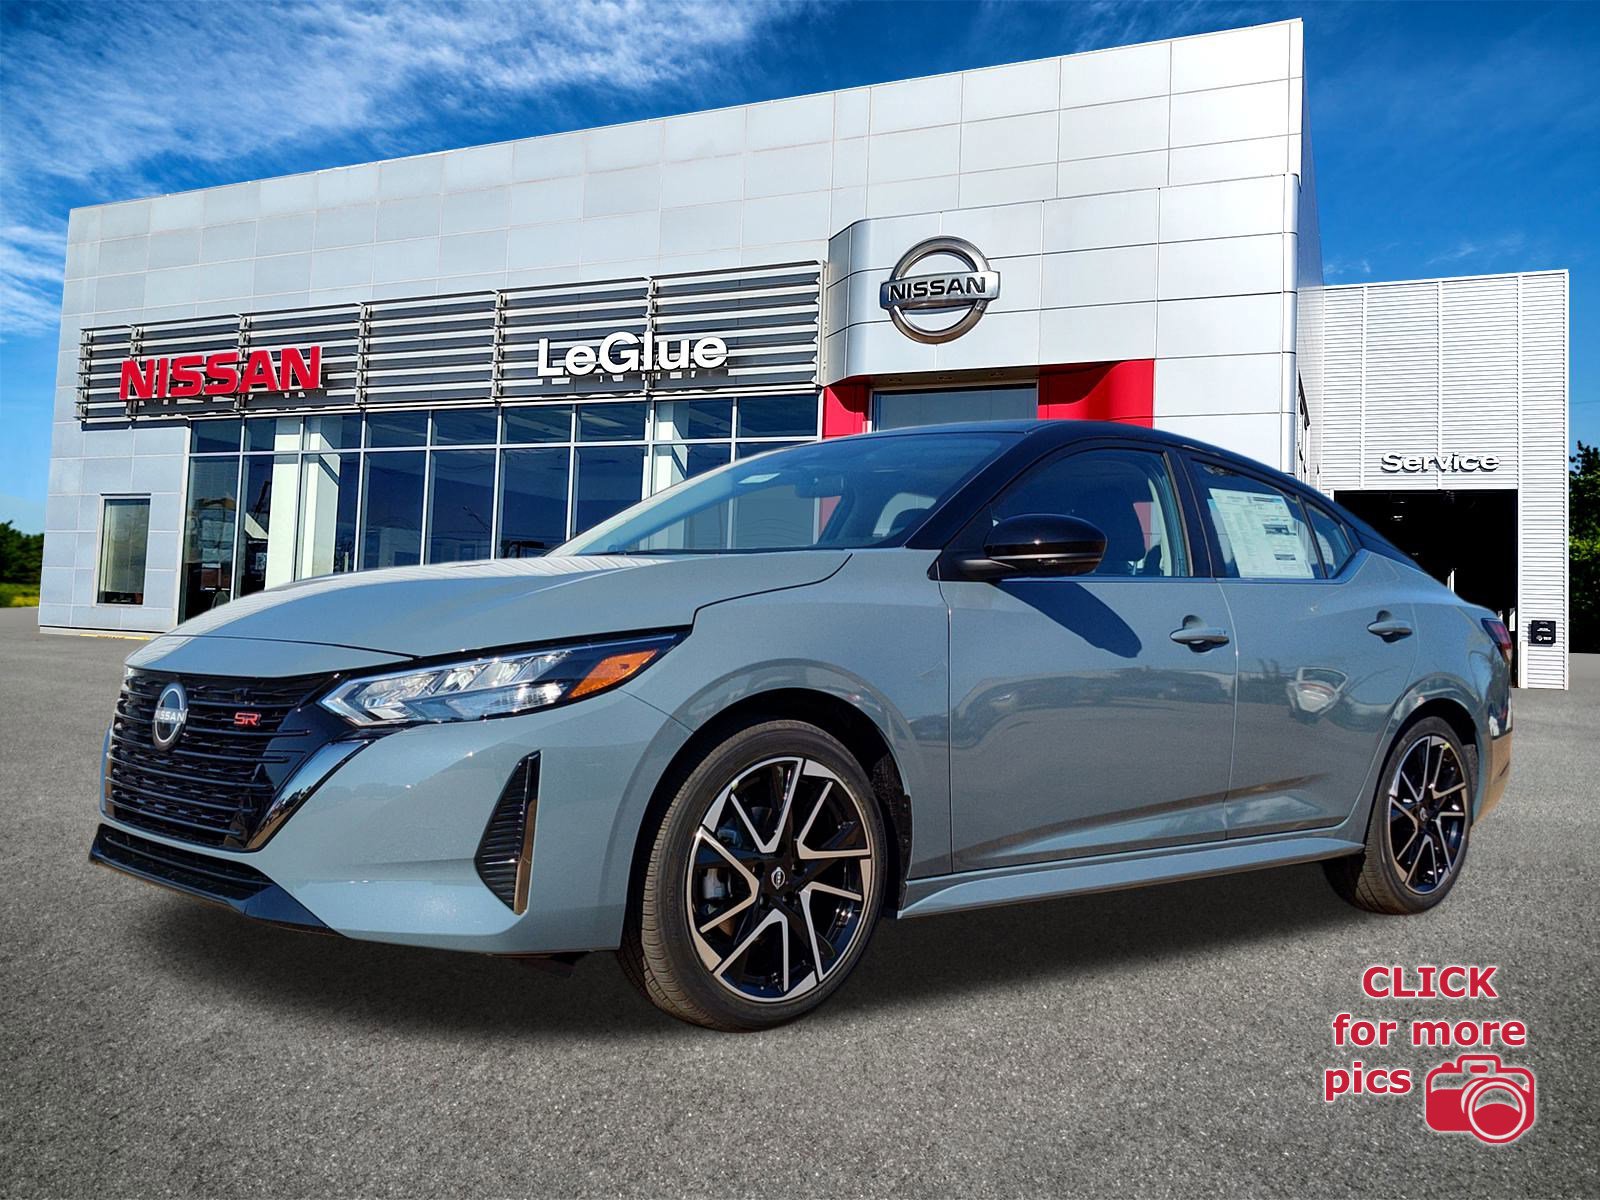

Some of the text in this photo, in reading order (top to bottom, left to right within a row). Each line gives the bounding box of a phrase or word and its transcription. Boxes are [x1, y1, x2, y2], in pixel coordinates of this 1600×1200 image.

[889, 277, 986, 301] NISSAN
[537, 331, 729, 378] LeGlue
[119, 346, 322, 400] NISSAN
[1381, 451, 1500, 472] Service
[154, 709, 185, 723] NISSAN
[234, 712, 259, 726] SR
